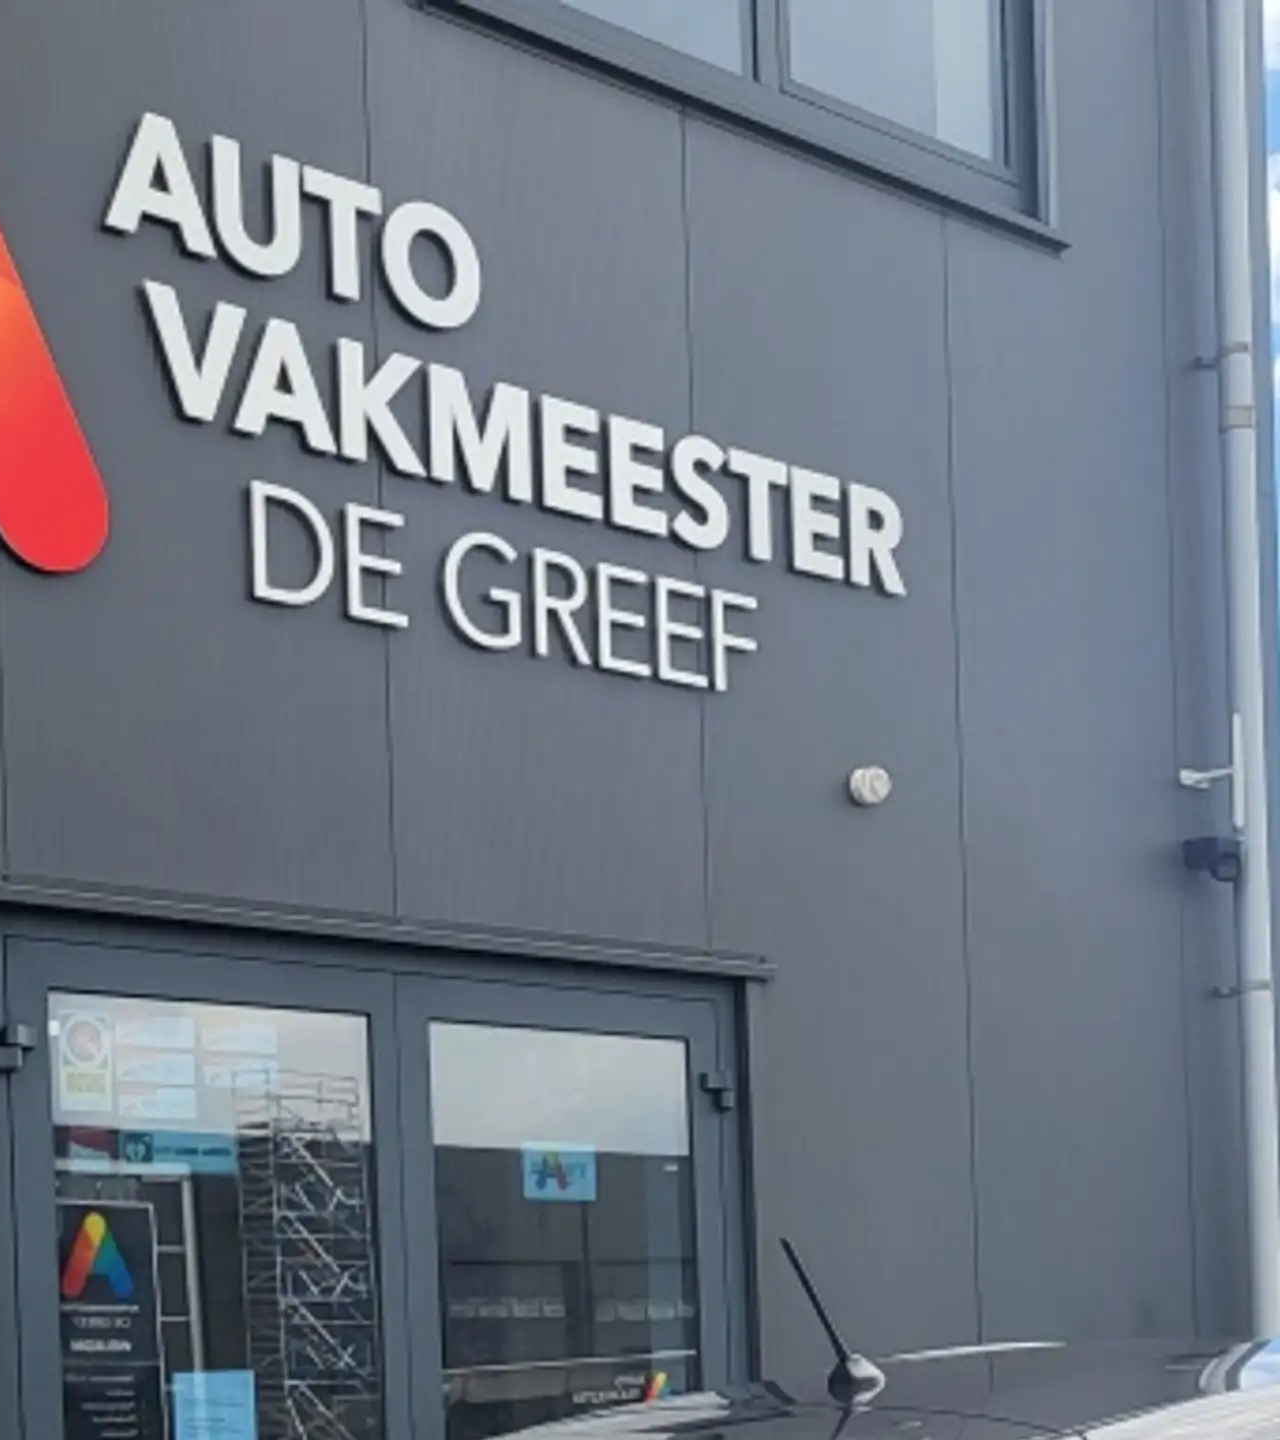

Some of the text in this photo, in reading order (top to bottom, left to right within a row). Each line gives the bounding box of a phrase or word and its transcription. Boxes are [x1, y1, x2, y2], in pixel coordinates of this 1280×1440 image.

[104, 110, 482, 329] AUTO
[142, 279, 907, 597] VAKMEESTER
[248, 479, 759, 692] DE GREEF
